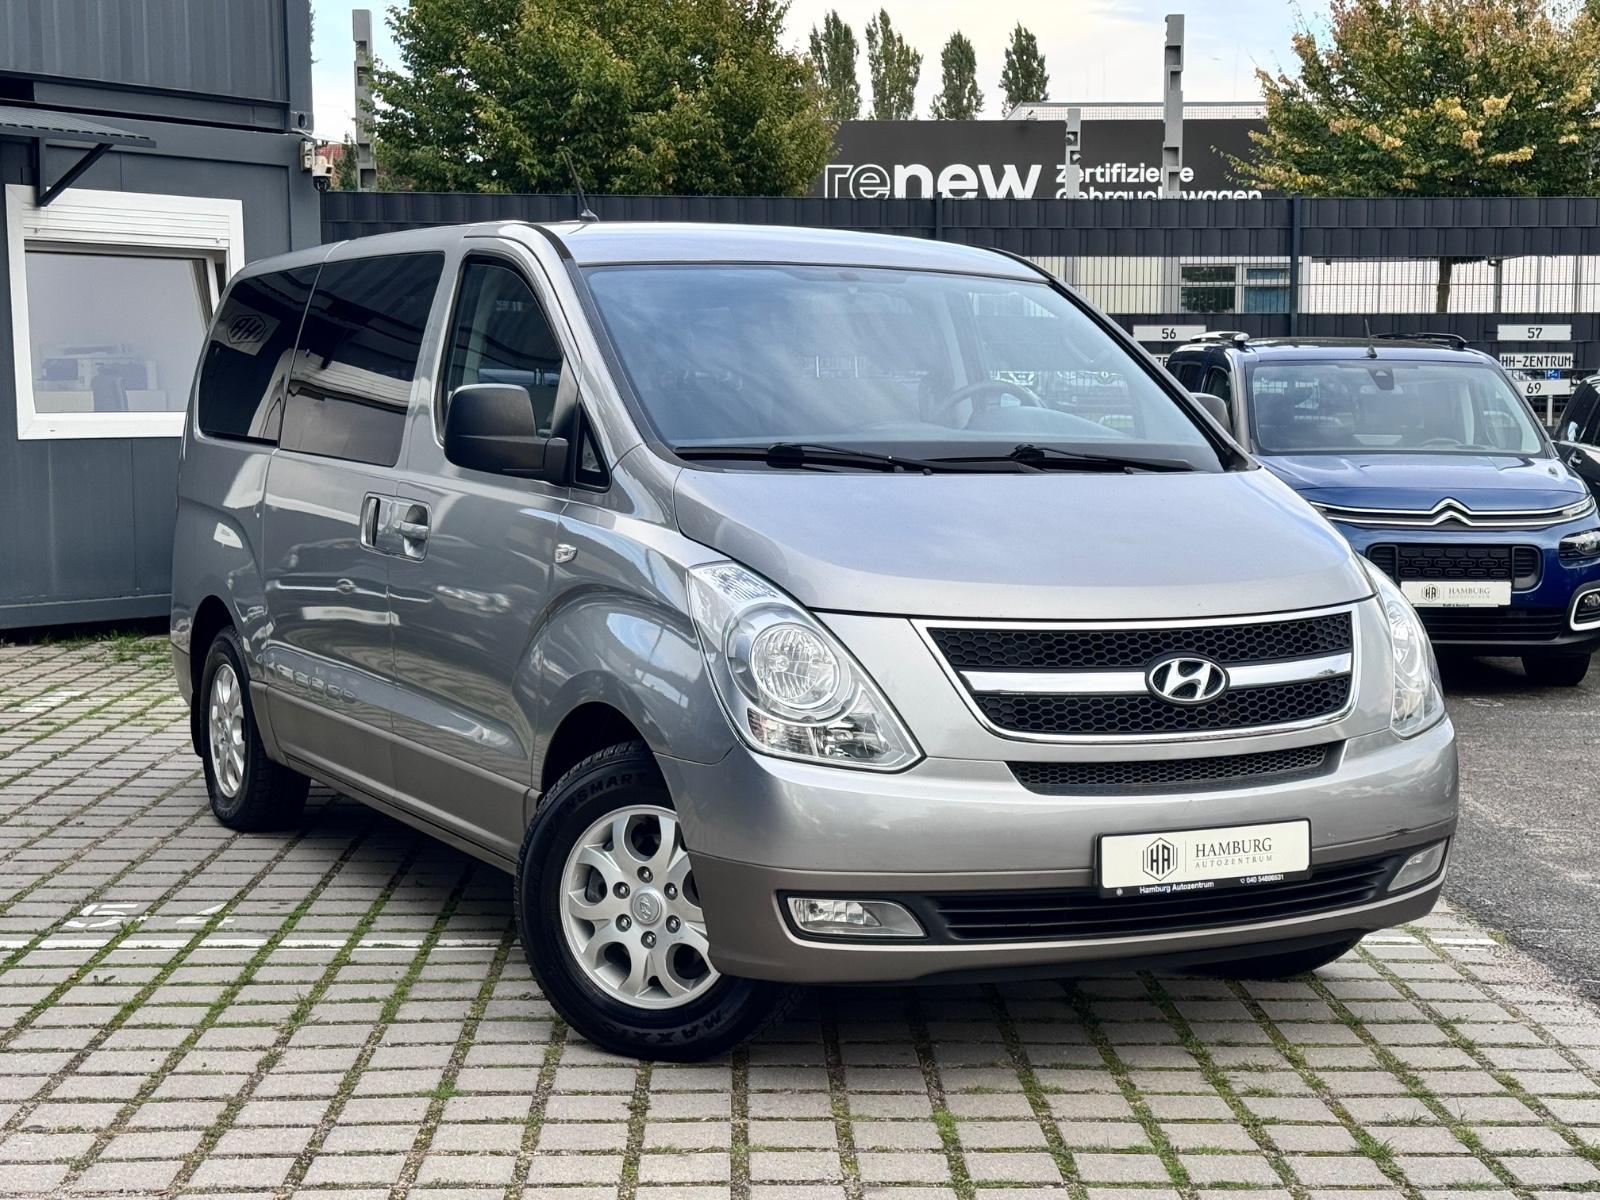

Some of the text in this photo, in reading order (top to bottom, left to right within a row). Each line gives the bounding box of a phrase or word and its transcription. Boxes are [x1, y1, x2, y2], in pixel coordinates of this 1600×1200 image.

[824, 164, 1043, 199] renew
[1161, 327, 1177, 340] 56
[1527, 327, 1543, 339] 57
[1501, 355, 1572, 367] HH-ZENTRUM
[1526, 382, 1542, 394] 69
[1195, 837, 1272, 858] HAMBURG
[1150, 843, 1171, 876] HA
[1195, 855, 1273, 869] AUTOZENTRUM
[1139, 881, 1215, 894] Hamburg Autozentrum
